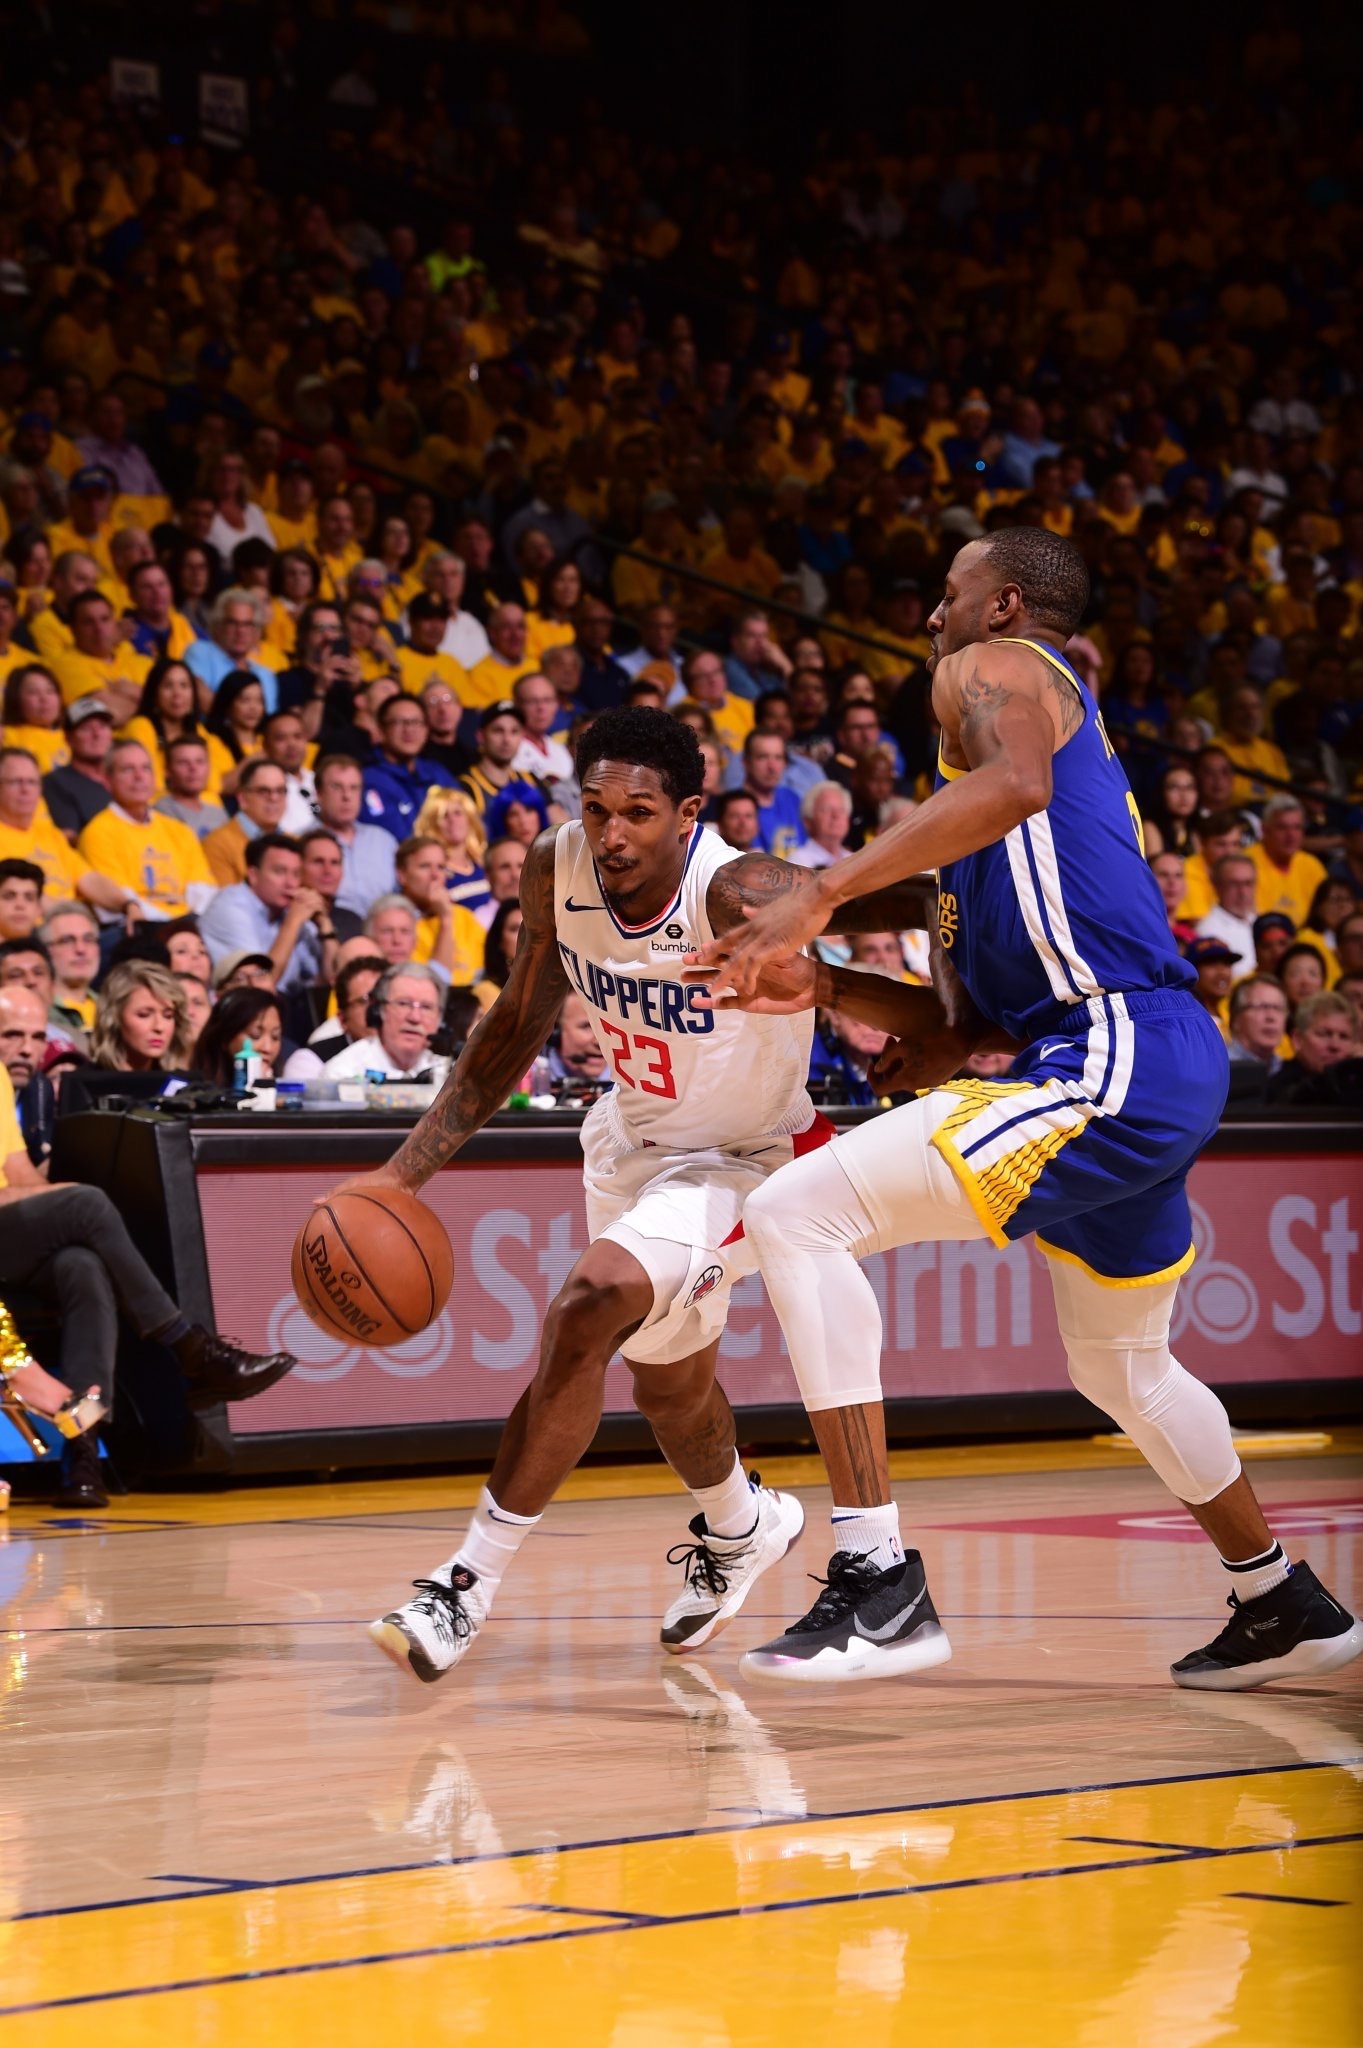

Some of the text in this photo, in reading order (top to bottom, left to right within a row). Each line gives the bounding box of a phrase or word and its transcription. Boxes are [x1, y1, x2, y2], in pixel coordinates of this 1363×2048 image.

[651, 940, 697, 953] bumble
[599, 1017, 677, 1100] 23
[306, 1234, 382, 1337] SPALDING
